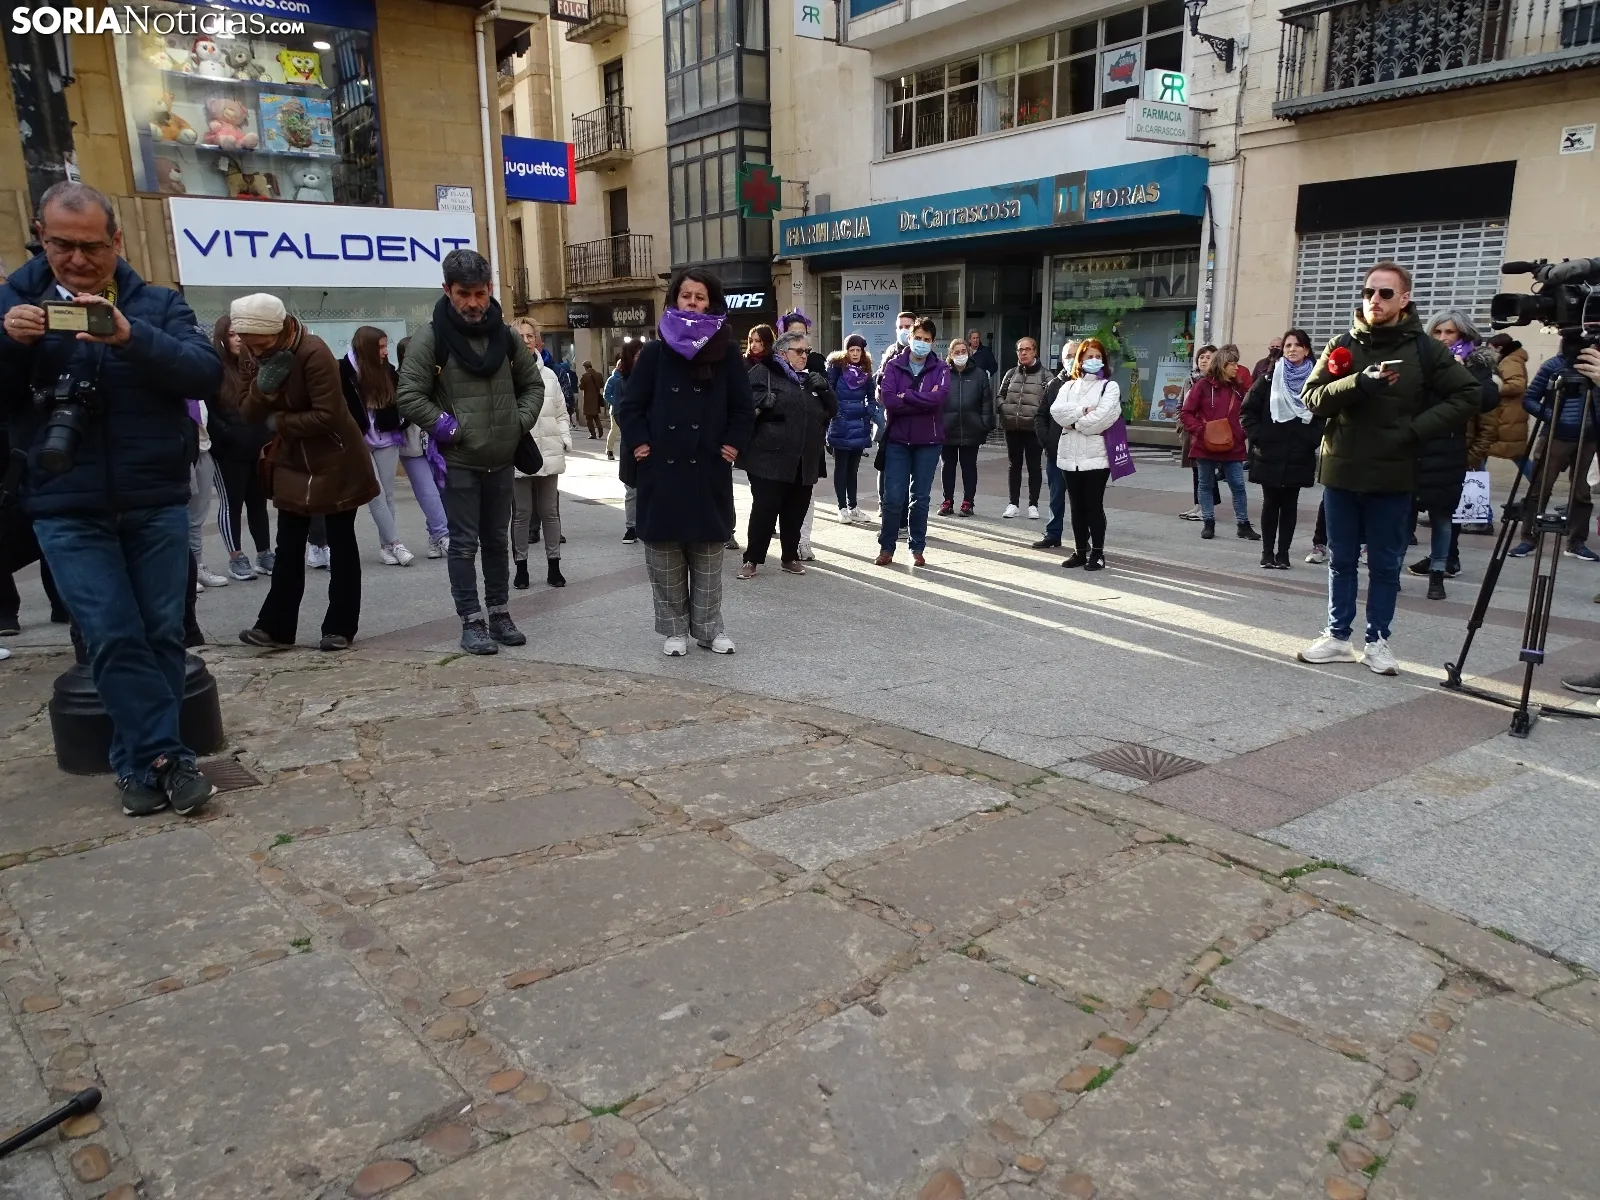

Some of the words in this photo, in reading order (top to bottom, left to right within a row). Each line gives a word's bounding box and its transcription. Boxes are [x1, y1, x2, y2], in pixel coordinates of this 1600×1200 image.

[557, 0, 588, 18] FOLCH
[1142, 107, 1182, 123] FARMACIA
[505, 157, 566, 178] juguettos
[785, 216, 871, 247] FARMACIA
[899, 211, 920, 232] Dr.
[921, 199, 1021, 229] Carrascosa
[1058, 185, 1079, 213] 11
[1089, 182, 1161, 210] HORAS
[183, 228, 471, 263] VITALDENT
[846, 279, 898, 291] PATYKA
[852, 304, 860, 312] EL
